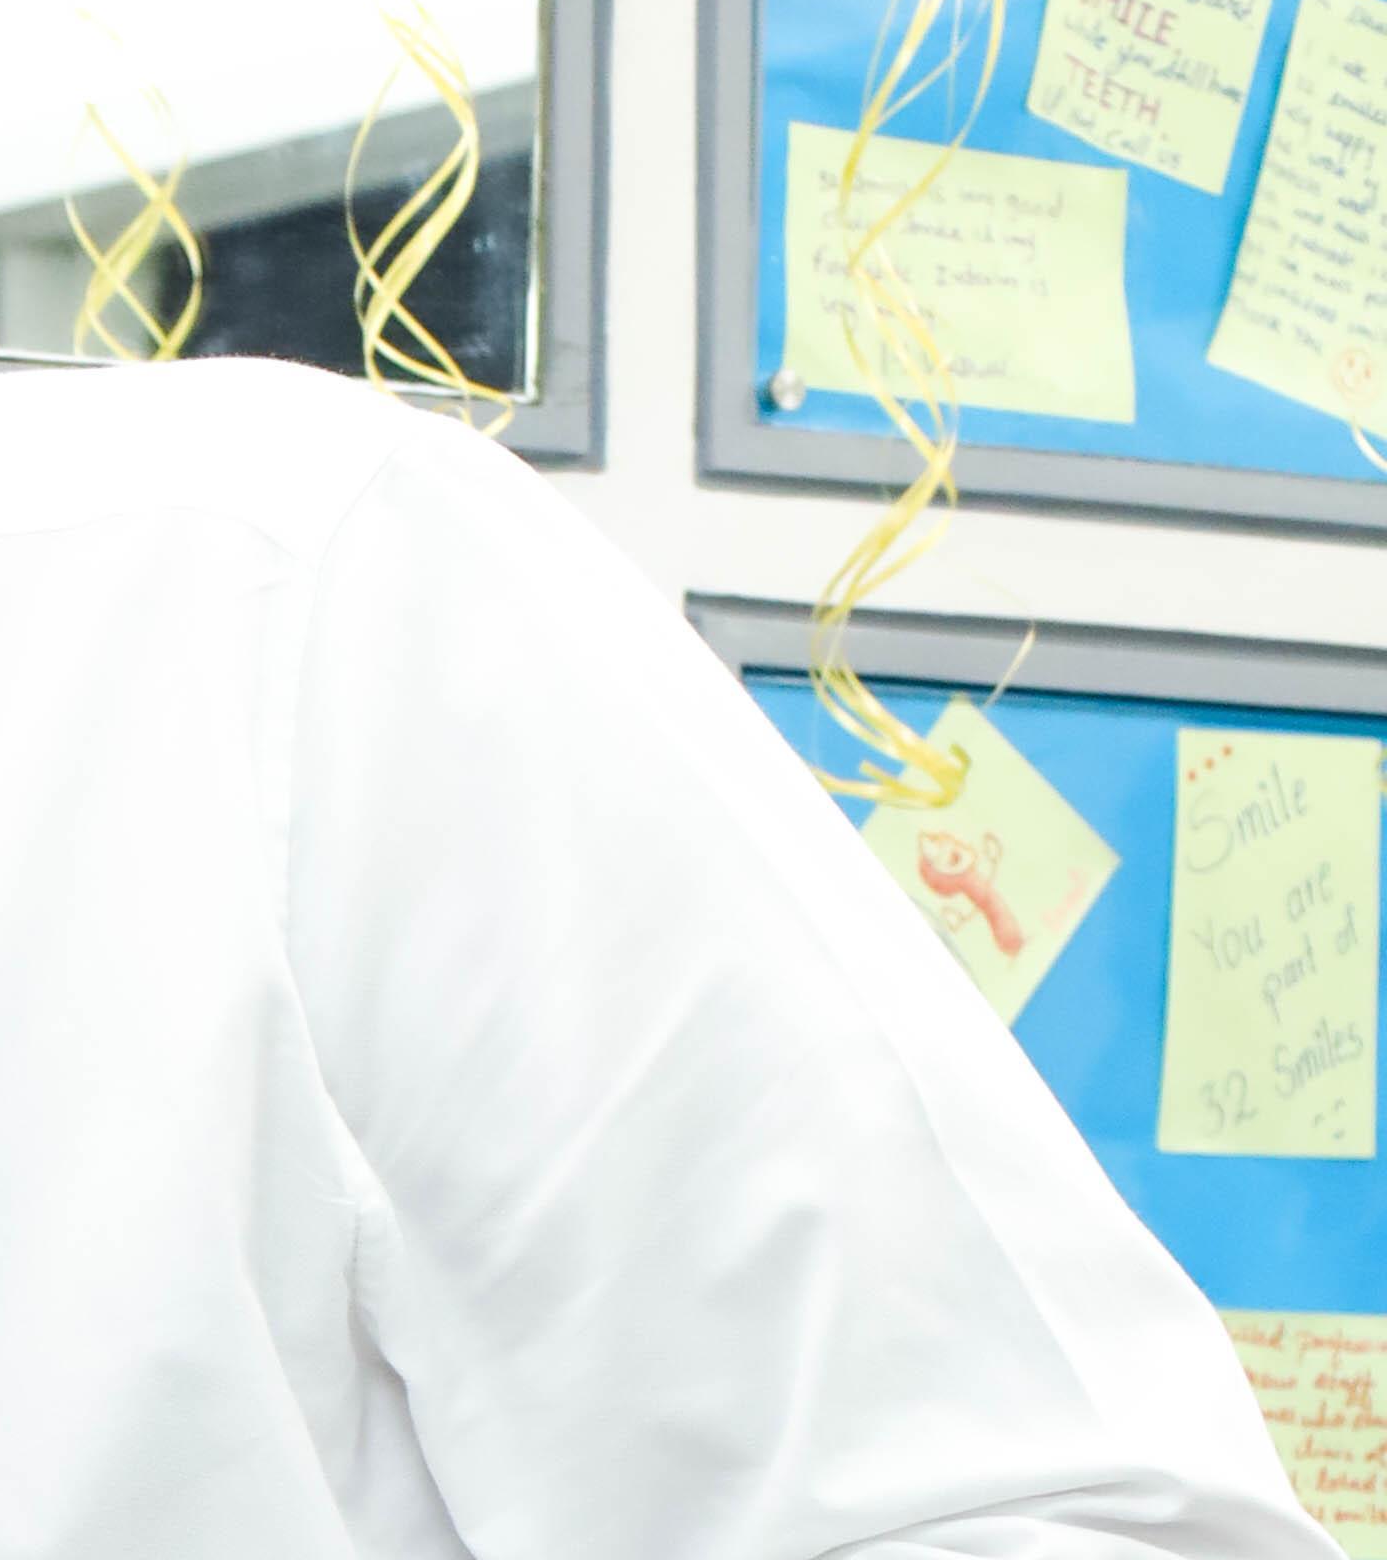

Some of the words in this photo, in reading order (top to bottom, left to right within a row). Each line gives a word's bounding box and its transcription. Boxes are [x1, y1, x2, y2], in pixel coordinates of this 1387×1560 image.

[1184, 761, 1310, 875] Smile
[1191, 915, 1266, 973] You
[1285, 859, 1334, 925] are
[1261, 931, 1319, 1025] part
[1334, 899, 1362, 958] of
[1199, 1068, 1258, 1137] 32
[1273, 1015, 1365, 1102] Smiles
